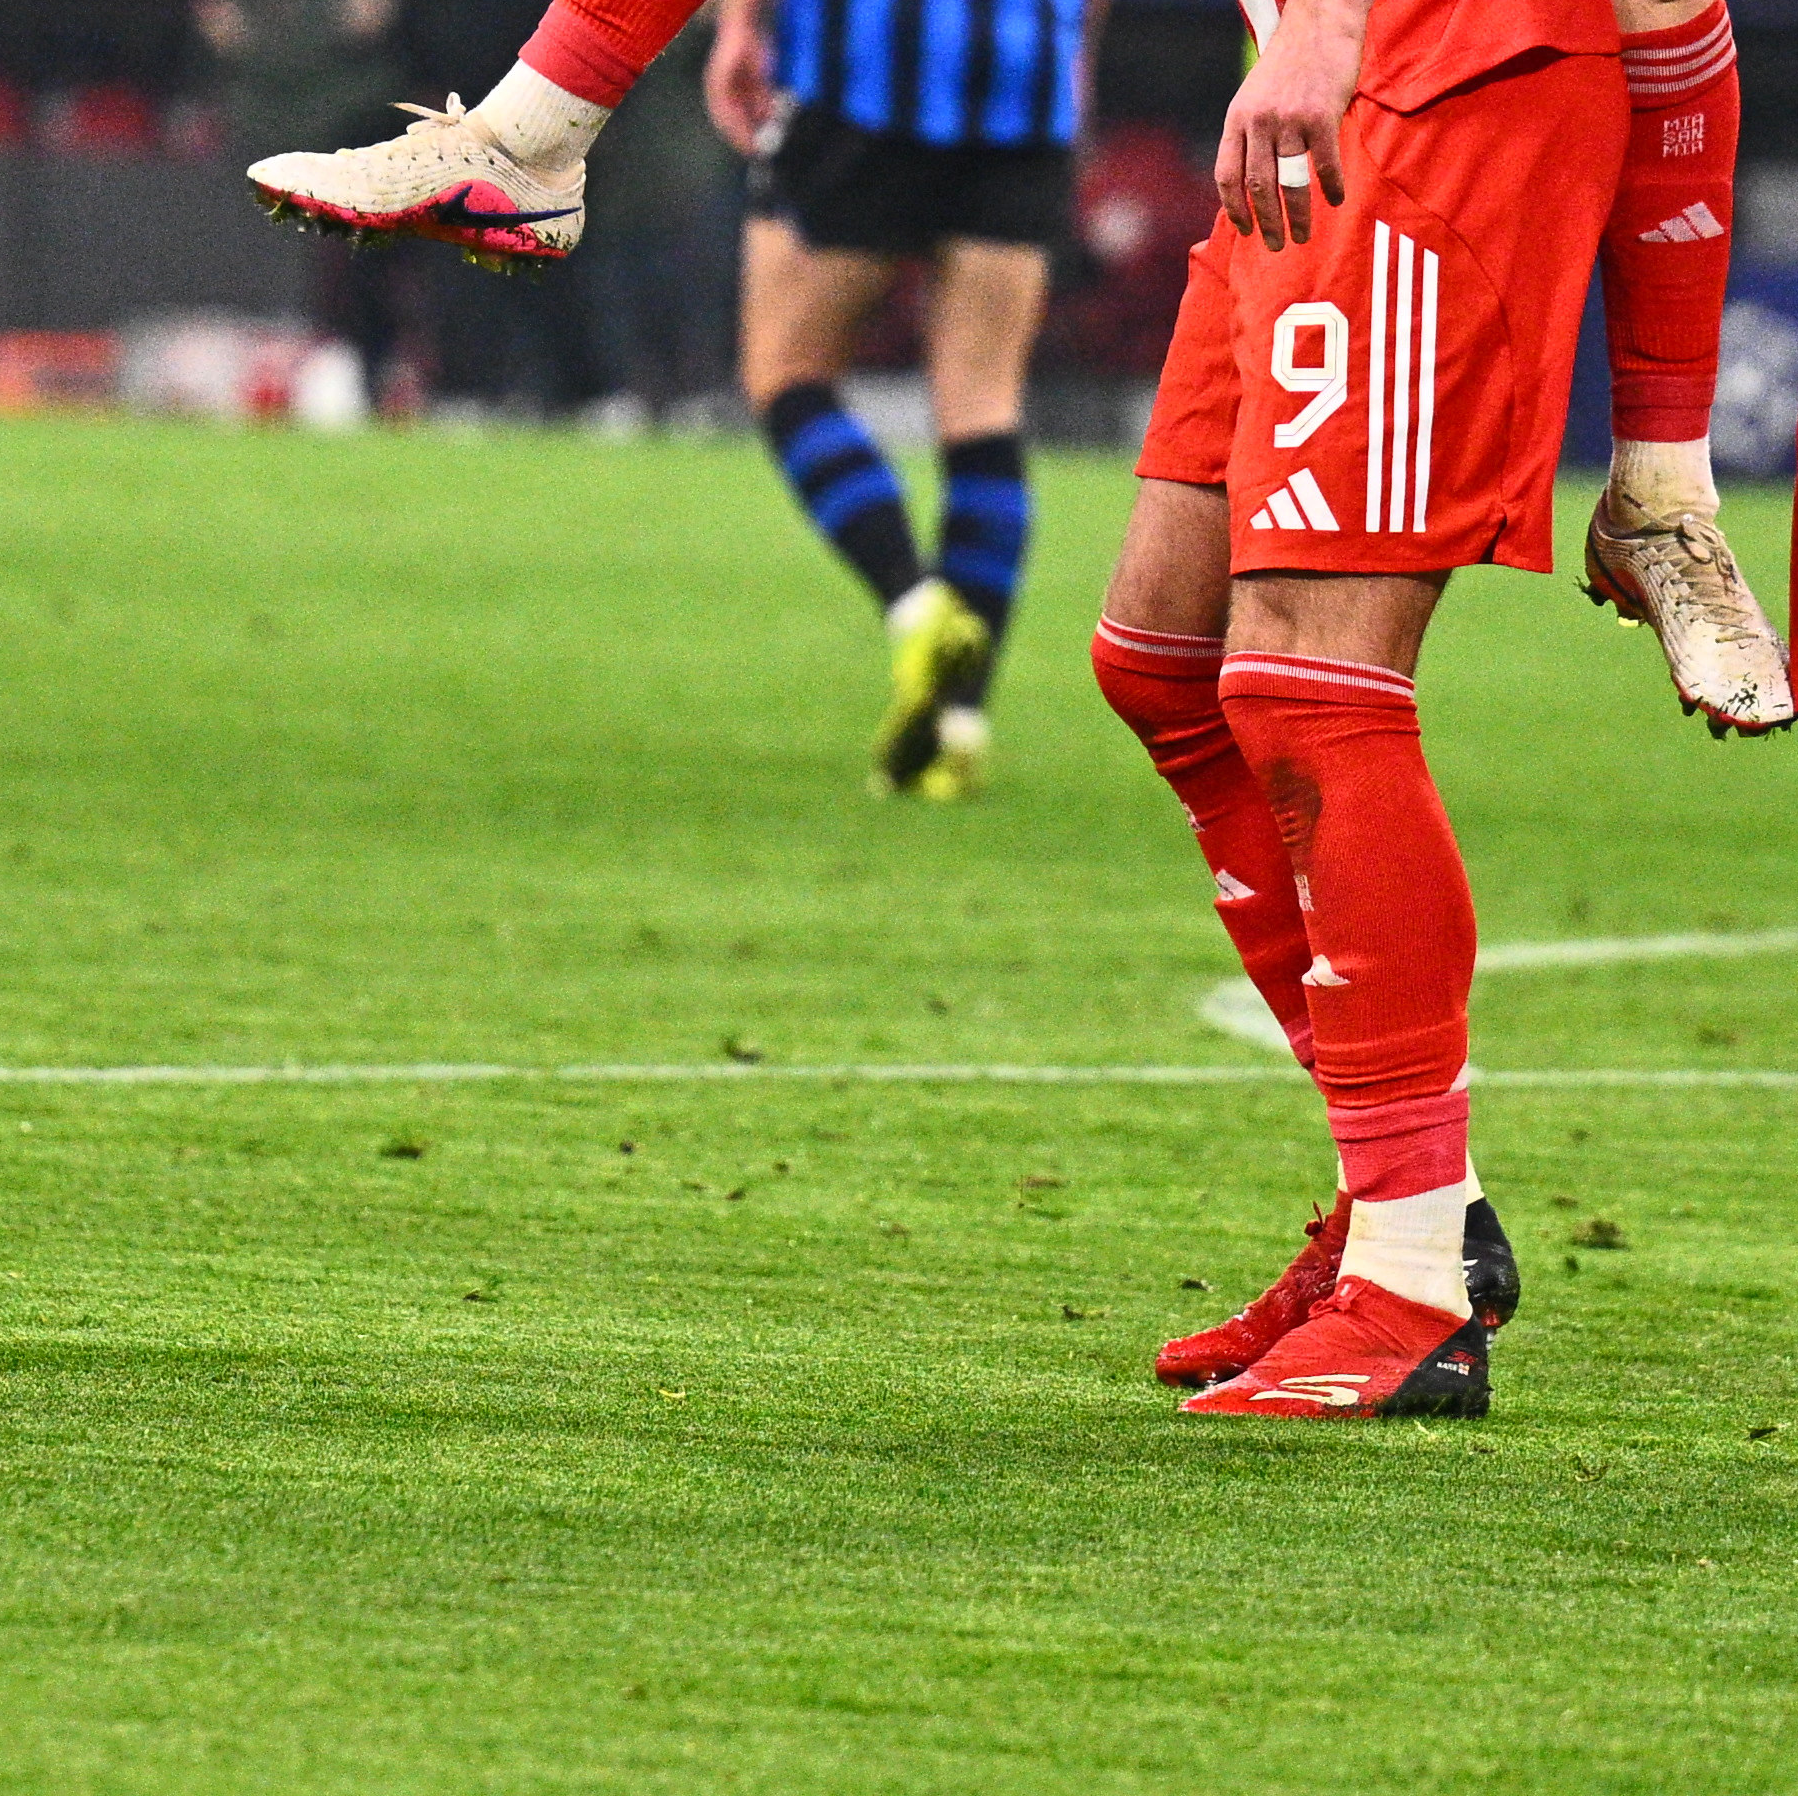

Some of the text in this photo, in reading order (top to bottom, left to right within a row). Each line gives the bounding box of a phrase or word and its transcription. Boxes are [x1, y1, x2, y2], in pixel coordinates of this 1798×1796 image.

[1663, 113, 1704, 132] MIA
[1663, 128, 1704, 144] SAN
[1663, 140, 1703, 157] MIA
[1271, 301, 1349, 448] 9
